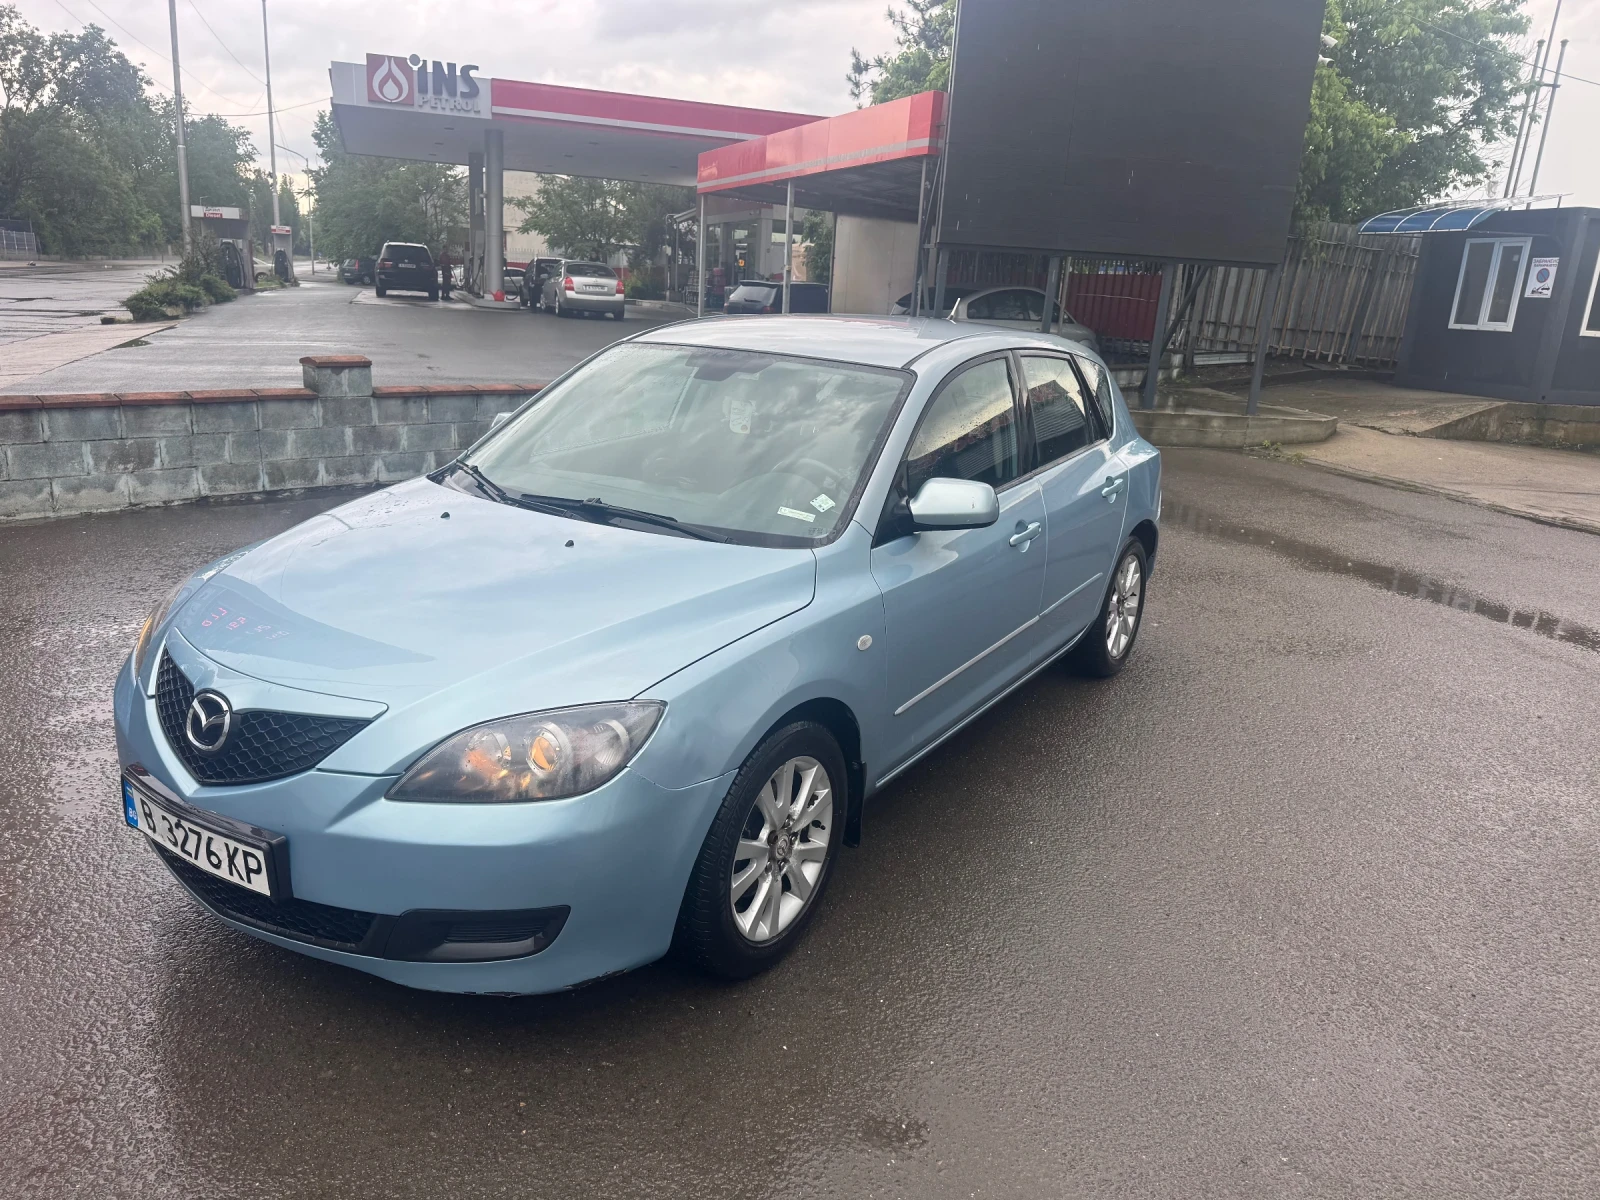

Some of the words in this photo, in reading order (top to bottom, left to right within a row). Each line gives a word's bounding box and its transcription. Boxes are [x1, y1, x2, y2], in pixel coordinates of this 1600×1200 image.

[417, 95, 481, 113] PETROL
[128, 806, 138, 821] BG
[140, 797, 157, 834] B
